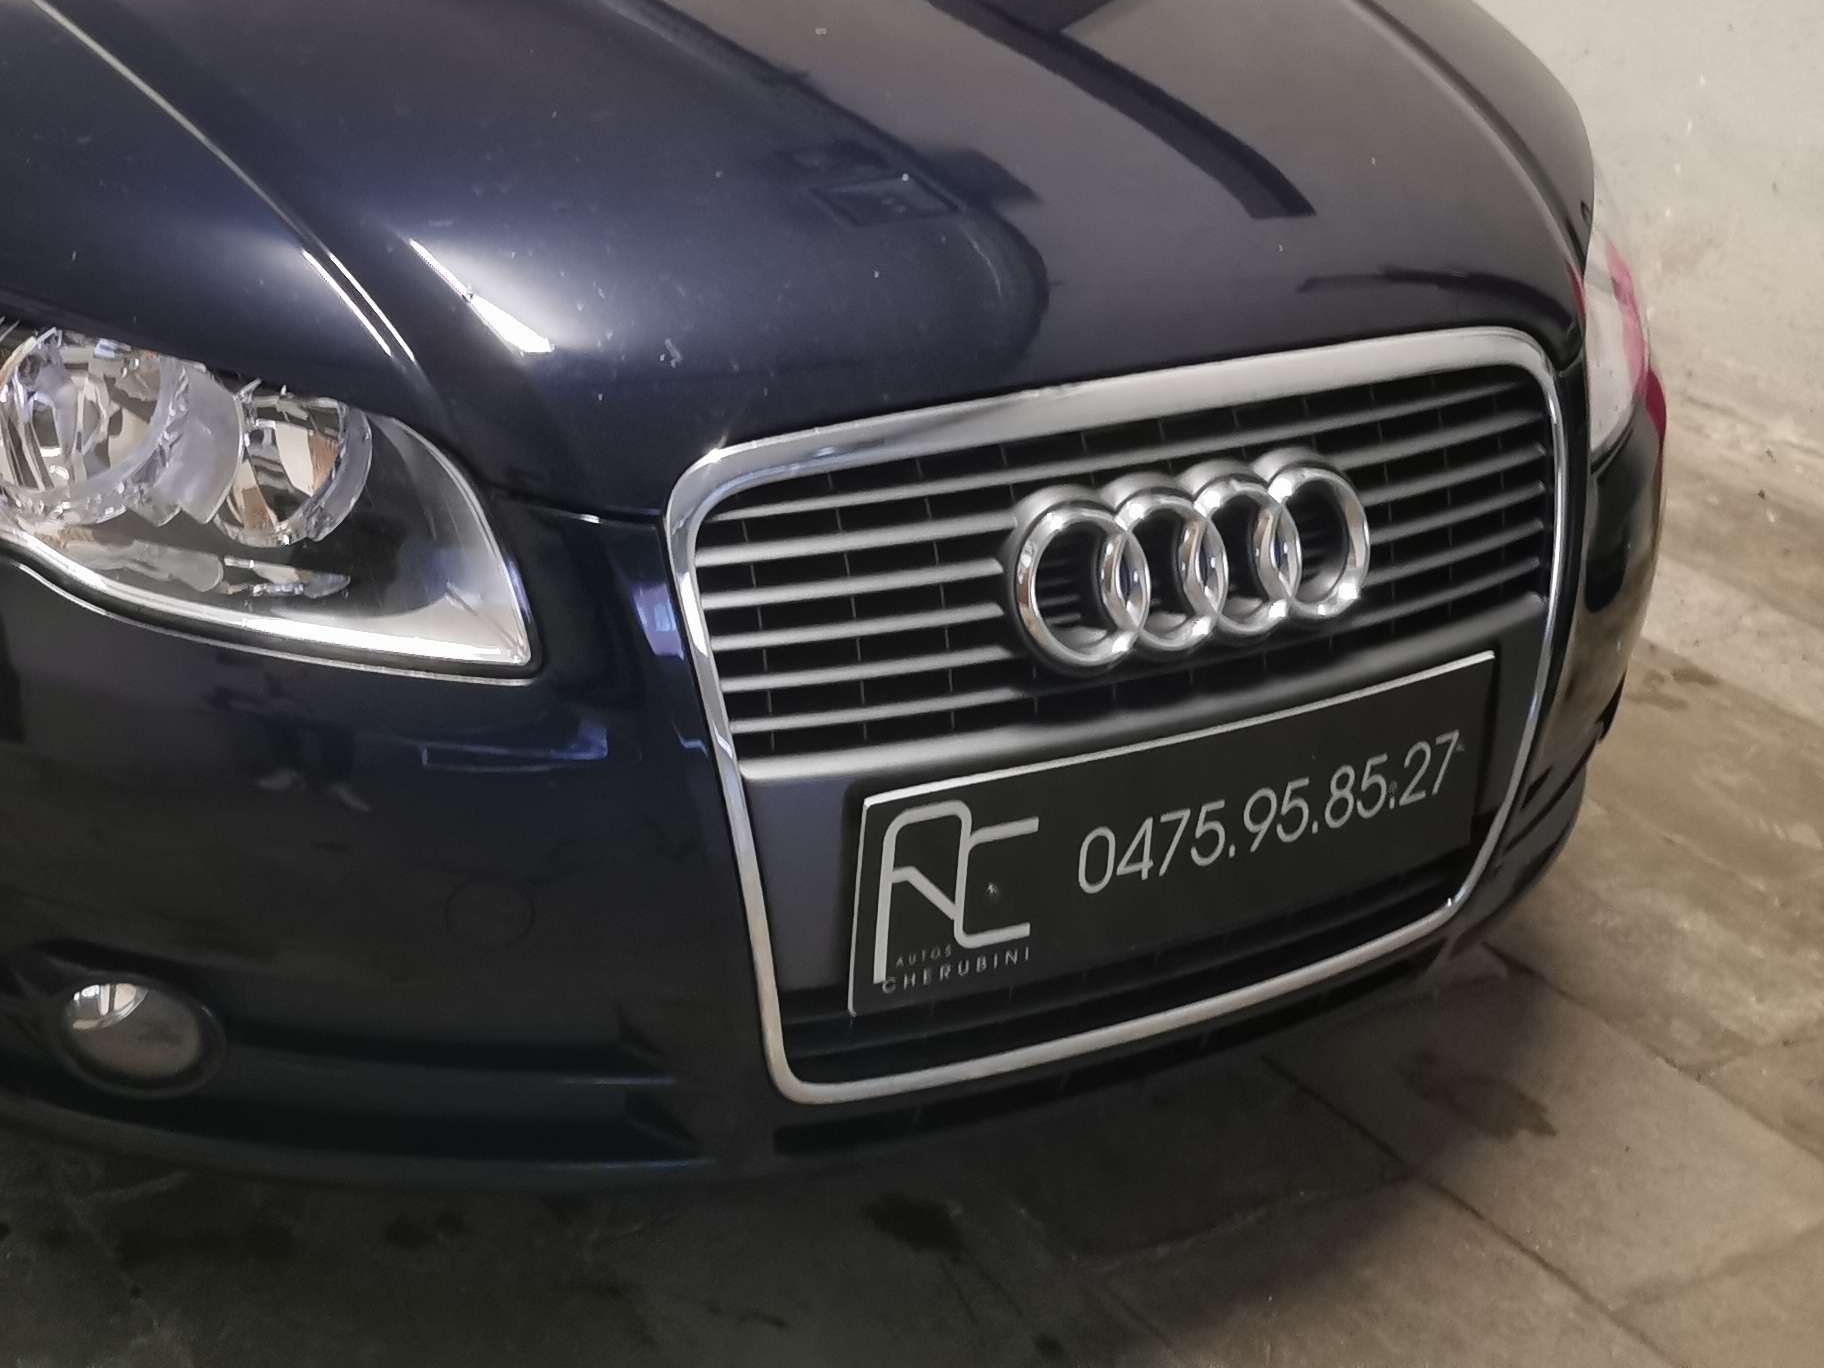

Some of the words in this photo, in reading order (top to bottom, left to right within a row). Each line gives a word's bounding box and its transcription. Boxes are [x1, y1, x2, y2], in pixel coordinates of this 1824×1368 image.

[1078, 730, 1460, 894] 0475.95.85.27
[882, 946, 1029, 994] CHERUBINI
[896, 944, 952, 968] AUTOS
